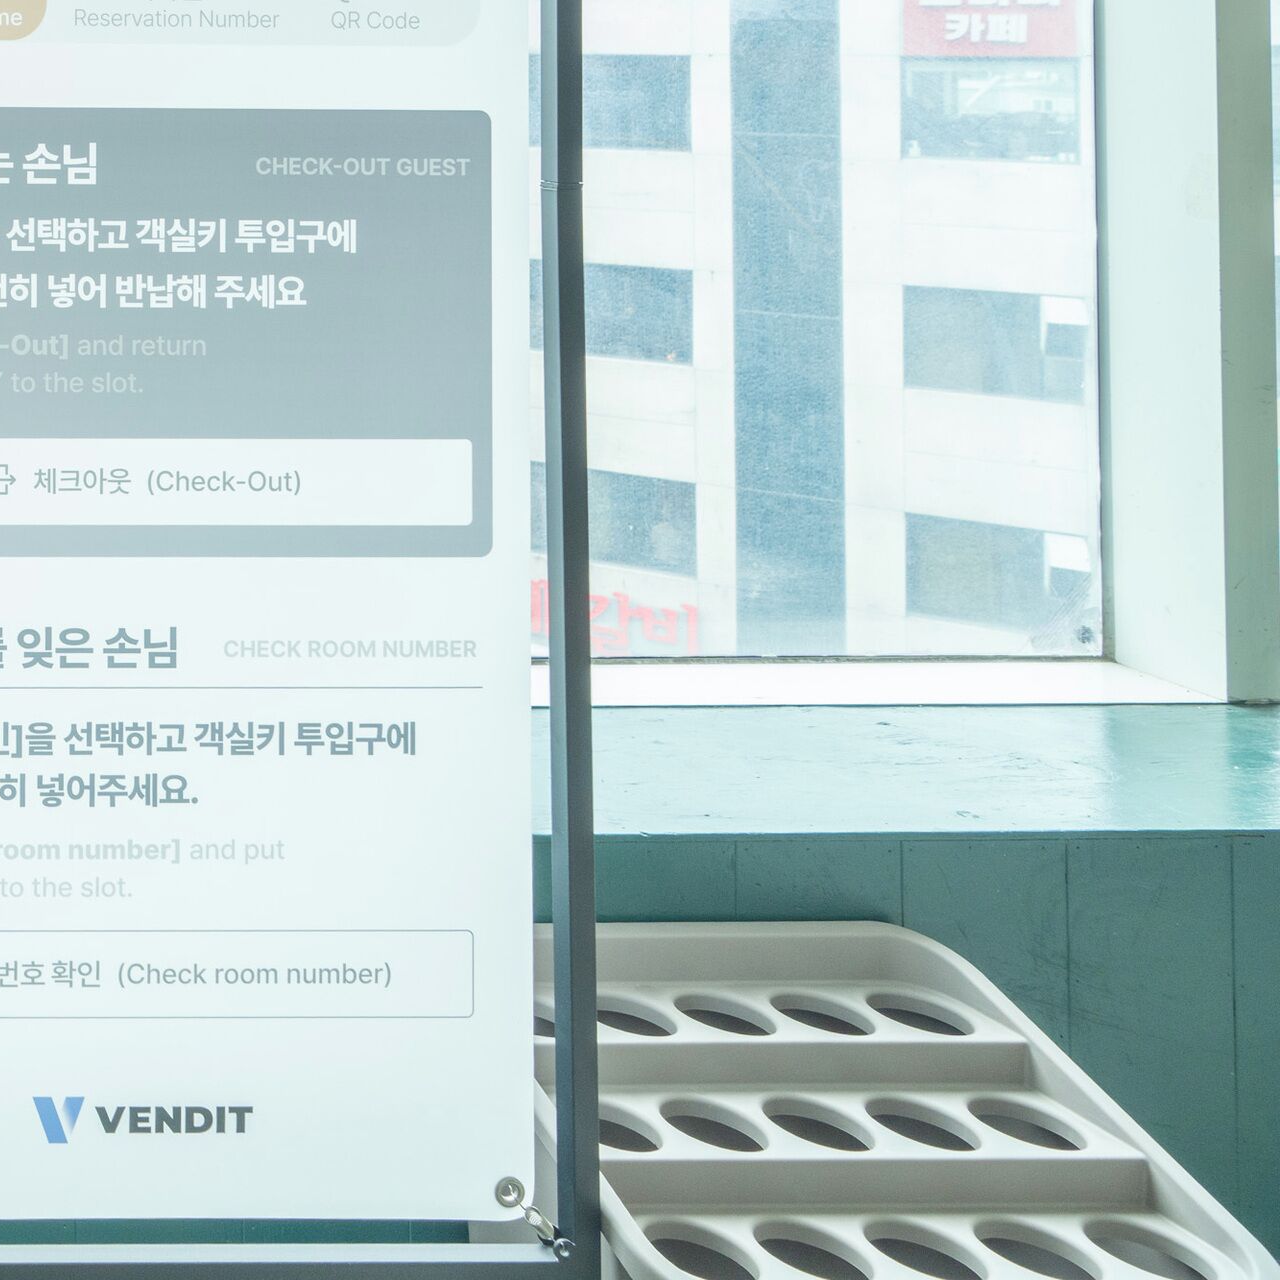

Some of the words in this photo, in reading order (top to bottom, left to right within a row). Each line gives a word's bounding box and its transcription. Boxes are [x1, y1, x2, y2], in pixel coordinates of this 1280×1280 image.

[75, 9, 191, 27] Reservation
[200, 10, 280, 28] Number
[331, 11, 360, 30] QR
[367, 11, 420, 29] Code
[944, 14, 1028, 43] 카페
[23, 143, 96, 184] 손님
[256, 157, 390, 175] CHECK-OUT
[397, 158, 470, 176] GUEST
[6, 218, 129, 252] 선택하고
[136, 218, 226, 253] 객실키
[235, 219, 356, 253] 투입구에
[48, 274, 106, 308] 넣어
[116, 274, 206, 308] 반납해
[214, 275, 307, 309] 주세요
[78, 335, 123, 355] and
[132, 336, 206, 355] return
[11, 373, 35, 392] to
[43, 372, 83, 392] the
[92, 372, 143, 393] slot.
[34, 468, 131, 494] 체크아웃
[148, 470, 300, 495] (Check-Out)
[17, 627, 93, 668] 잊은
[103, 627, 176, 668] 손님
[64, 722, 187, 756] 선택하고
[194, 722, 284, 755] 객실키
[294, 722, 415, 755] 투입구에
[51, 960, 100, 988] 확인
[119, 963, 207, 988] (Check
[216, 968, 278, 984] room
[288, 962, 391, 988] number)
[95, 1106, 253, 1133] VENDIT
